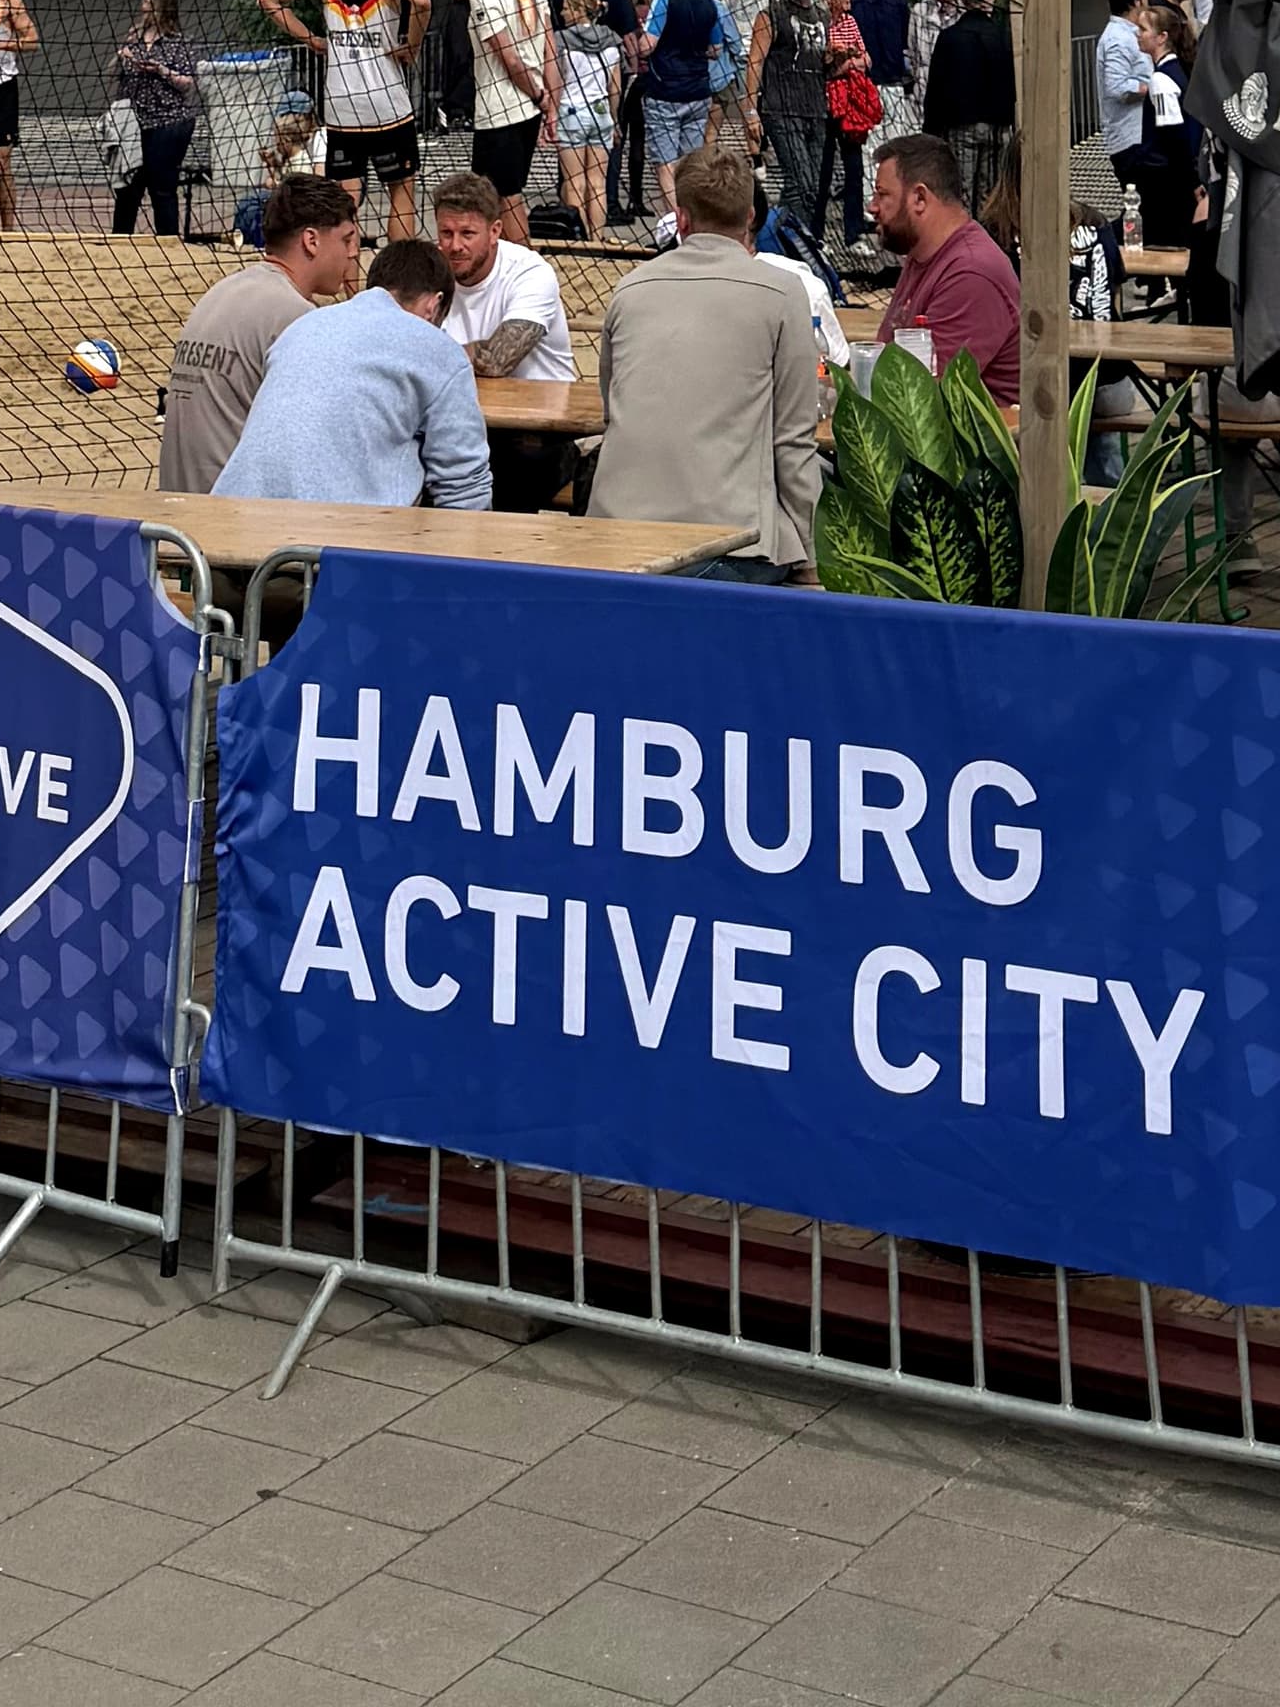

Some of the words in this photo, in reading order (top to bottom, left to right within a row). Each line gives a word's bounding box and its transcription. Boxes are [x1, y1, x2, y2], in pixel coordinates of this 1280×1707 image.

[293, 683, 1042, 906] HAMBURG
[280, 865, 791, 1071] ACTIVE
[853, 945, 1205, 1135] CITY
